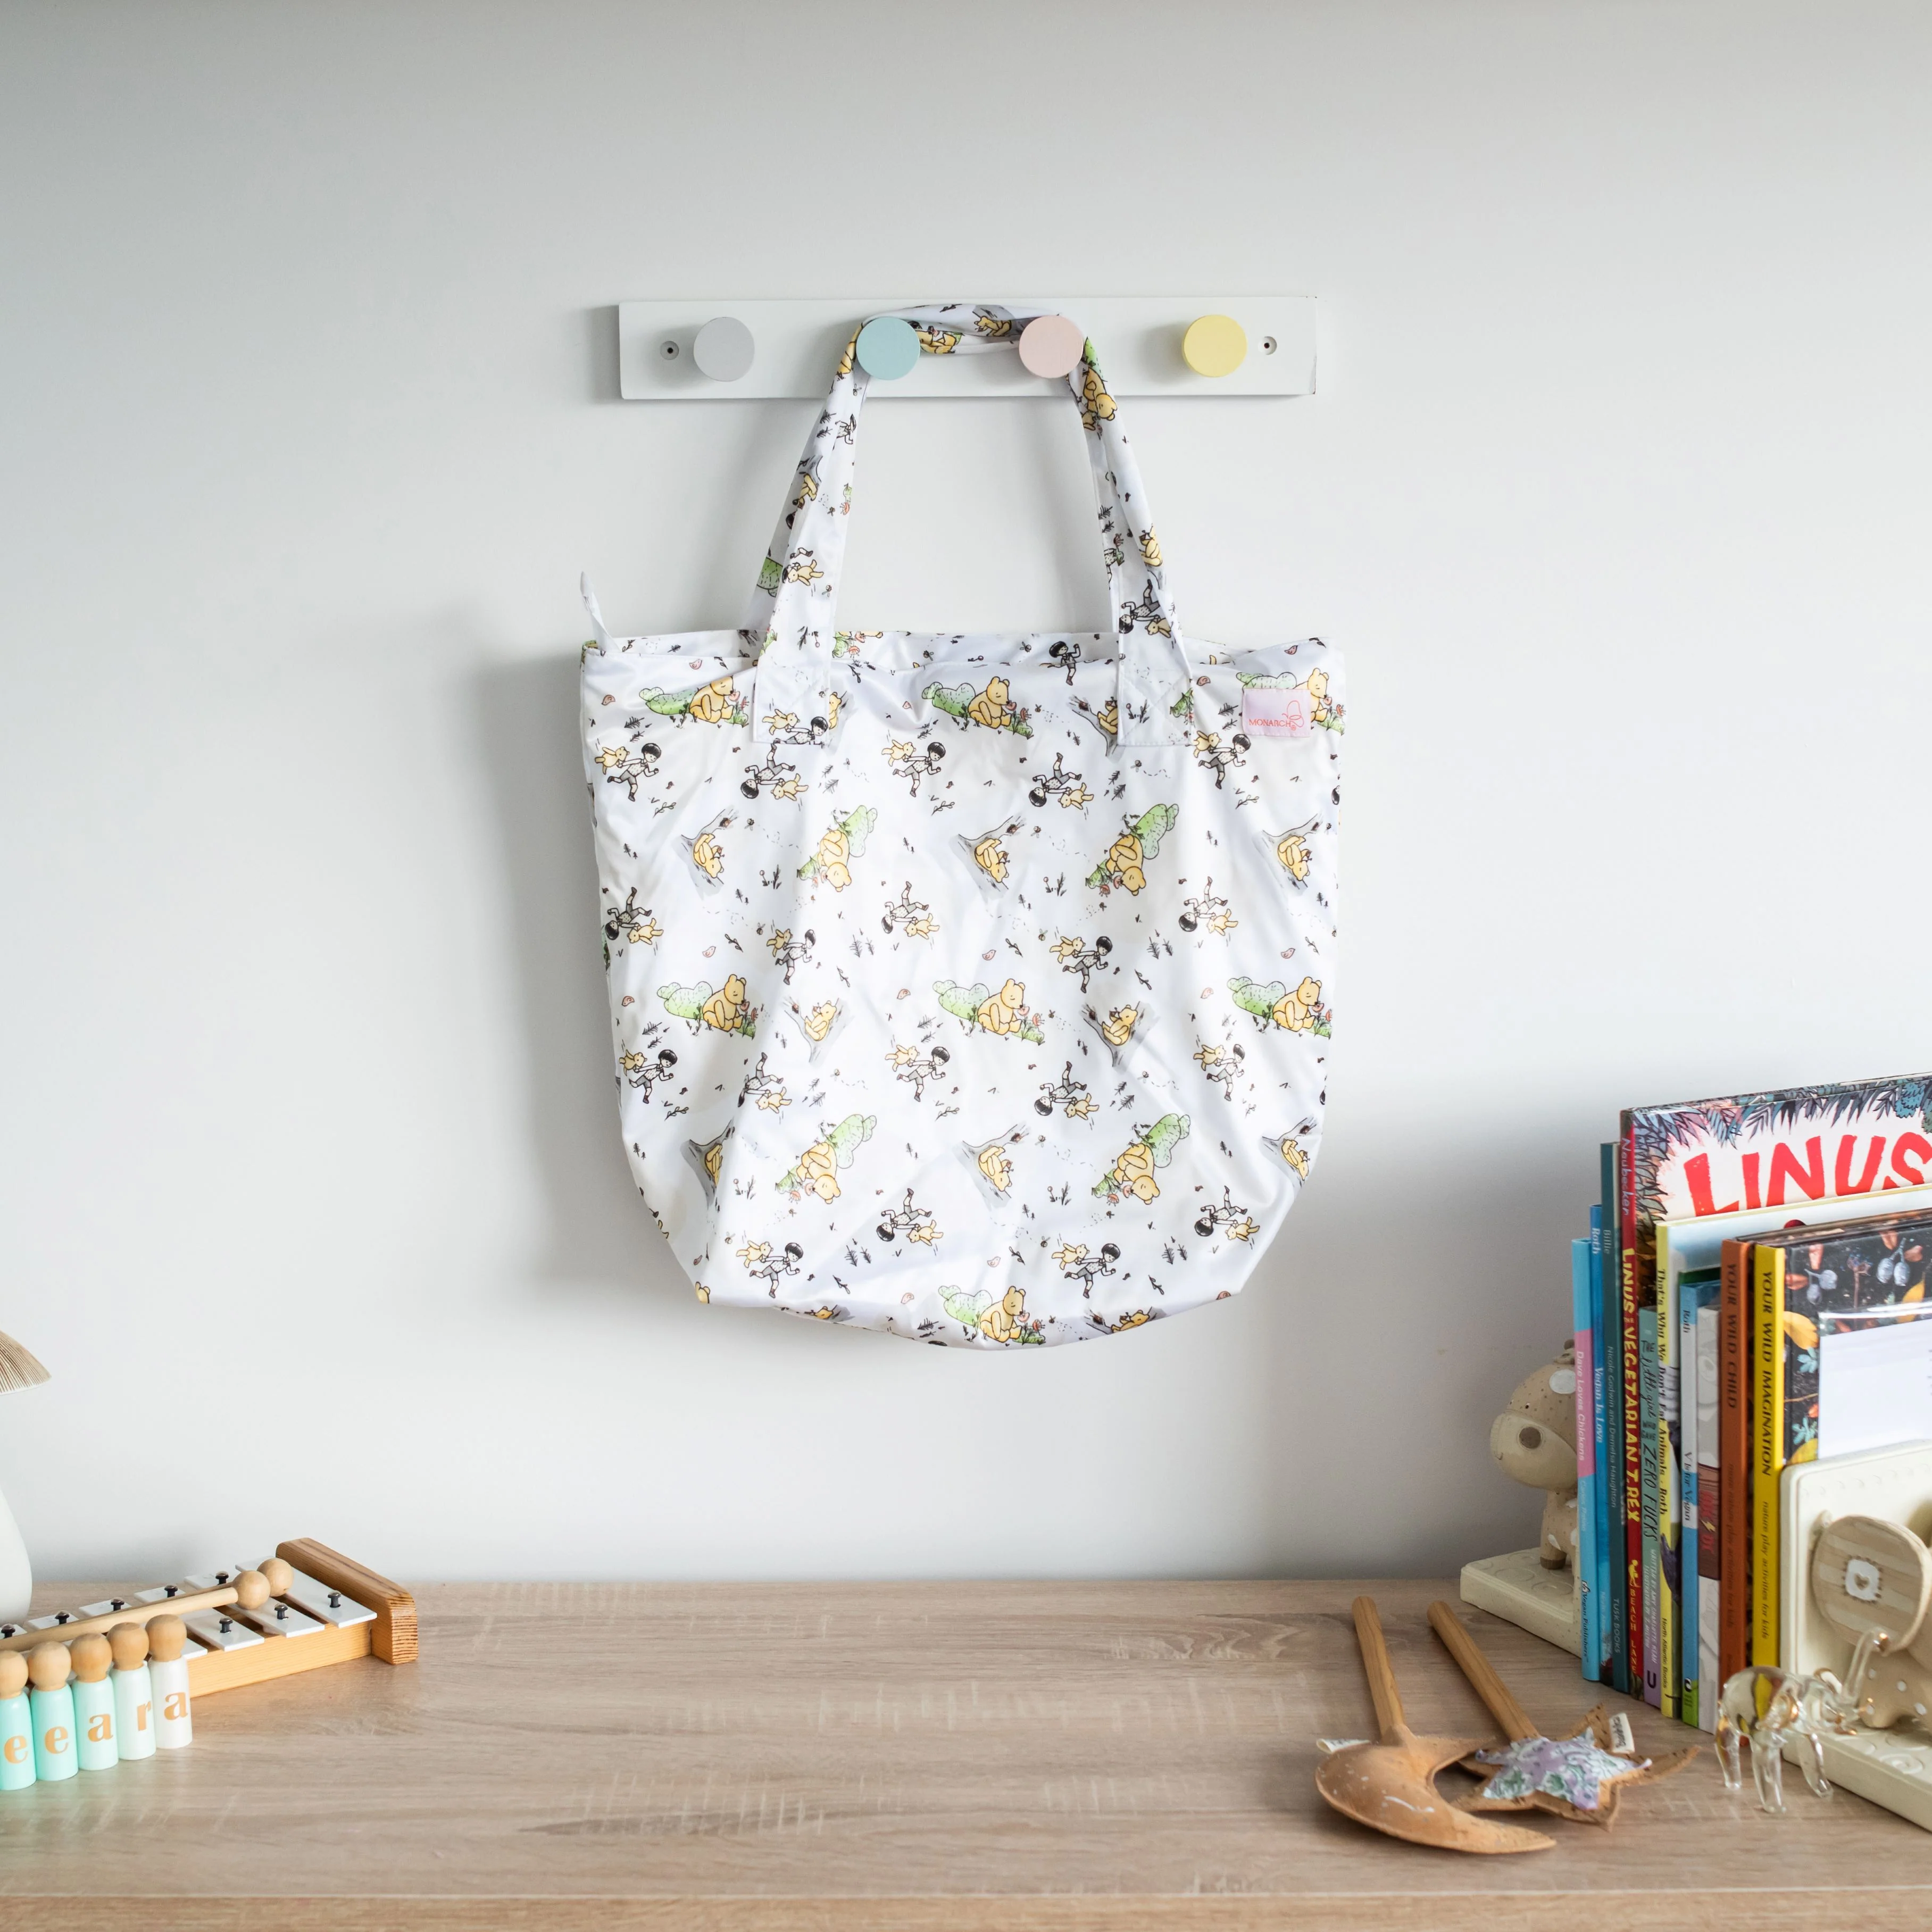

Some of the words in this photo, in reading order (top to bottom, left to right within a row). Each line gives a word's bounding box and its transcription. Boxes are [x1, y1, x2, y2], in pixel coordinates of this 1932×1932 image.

[1248, 719, 1291, 728] MONARCH
[1621, 1138, 1634, 1215] Neubecker
[1683, 1131, 1932, 1217] LINUS
[1592, 1228, 1601, 1255] Roth
[1603, 1230, 1612, 1254] Billie
[1622, 1247, 1635, 1313] LINUS
[1658, 1269, 1666, 1305] That's
[1727, 1263, 1737, 1306] YOUR
[1762, 1271, 1773, 1314] YOUR
[1658, 1344, 1666, 1362] We
[1726, 1314, 1737, 1354] WILD
[1762, 1322, 1773, 1362] WILD
[1595, 1367, 1604, 1400] Vegan
[1624, 1326, 1639, 1461] VEGETARIAN
[1727, 1361, 1737, 1409] CHILD
[1578, 1414, 1586, 1461] Chickens
[1761, 1370, 1773, 1476] IMAGINATION
[1643, 1443, 1657, 1489] ZERO
[1684, 1451, 1693, 1461] V
[1643, 1494, 1658, 1542] FUCKS
[1660, 1488, 1668, 1515] Roth
[1683, 1490, 1693, 1521] Vegan
[1761, 1534, 1771, 1556] play
[1761, 1558, 1770, 1601] activities
[1761, 1619, 1770, 1639] kids
